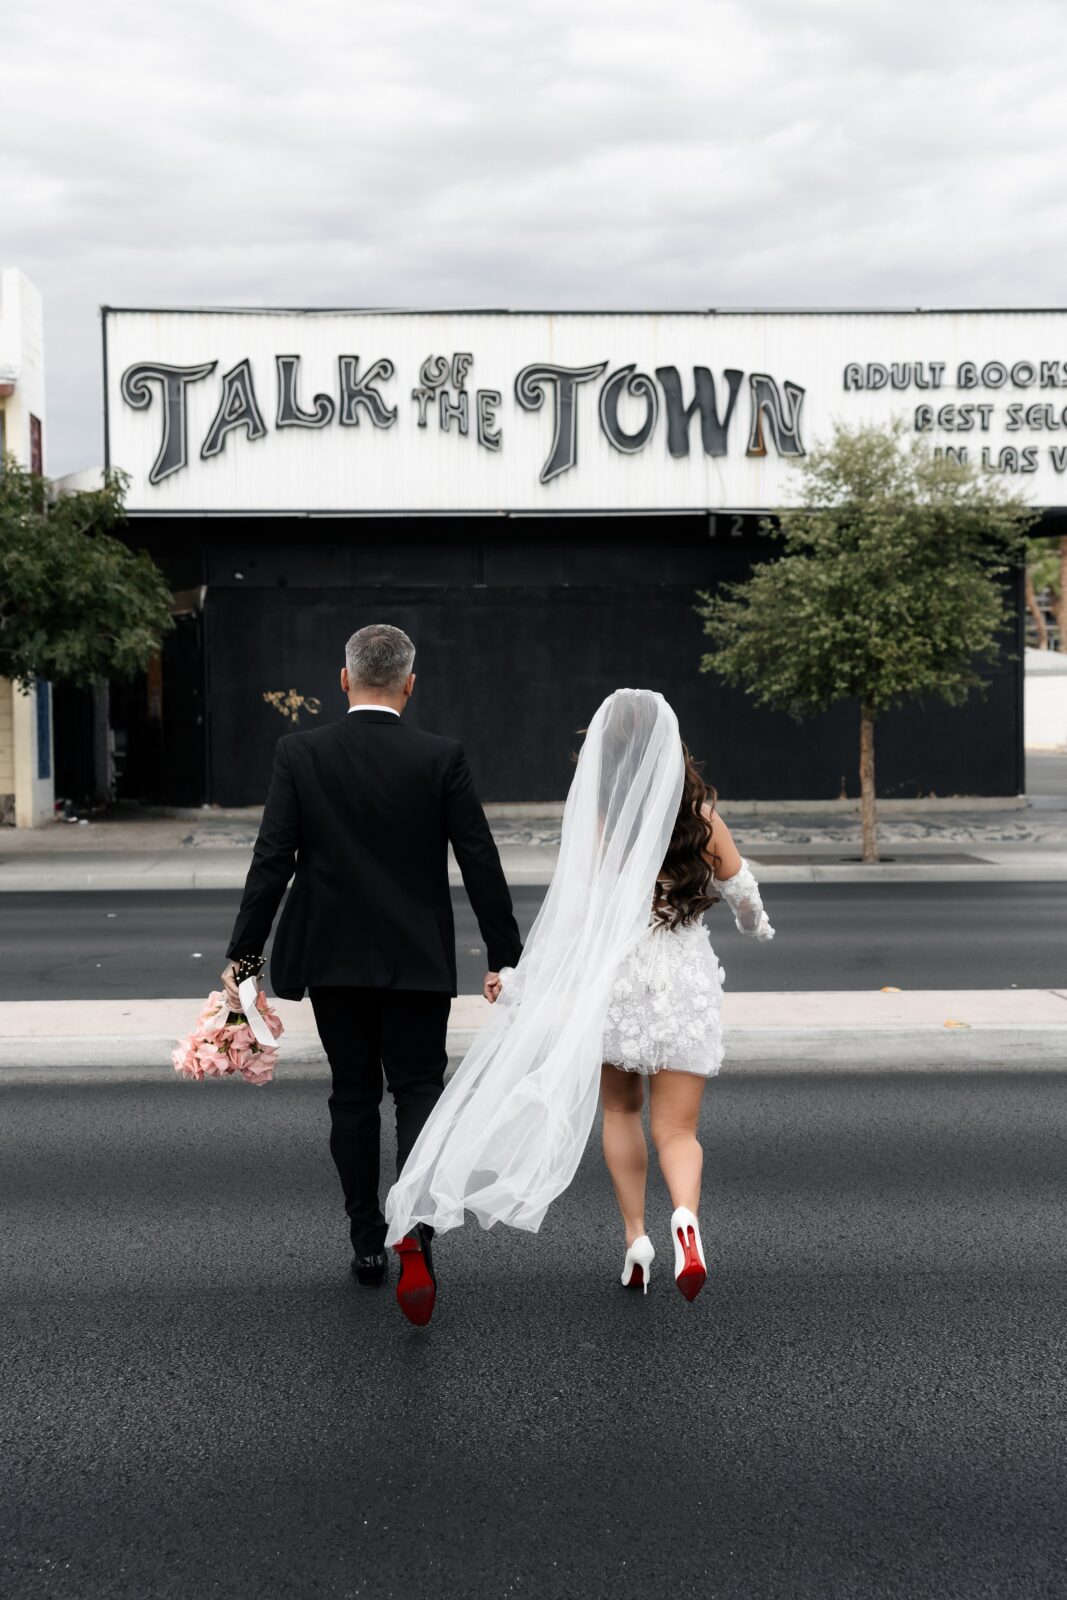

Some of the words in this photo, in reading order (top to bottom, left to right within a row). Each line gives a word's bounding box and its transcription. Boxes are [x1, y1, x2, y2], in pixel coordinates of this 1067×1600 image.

[419, 352, 475, 389] OF
[843, 360, 946, 391] ADULT
[957, 359, 1067, 390] BOOK
[121, 354, 398, 485] TALK
[411, 386, 502, 451] THE
[514, 359, 807, 485] TOWN
[914, 403, 994, 432] BEST
[982, 446, 1038, 474] LAS
